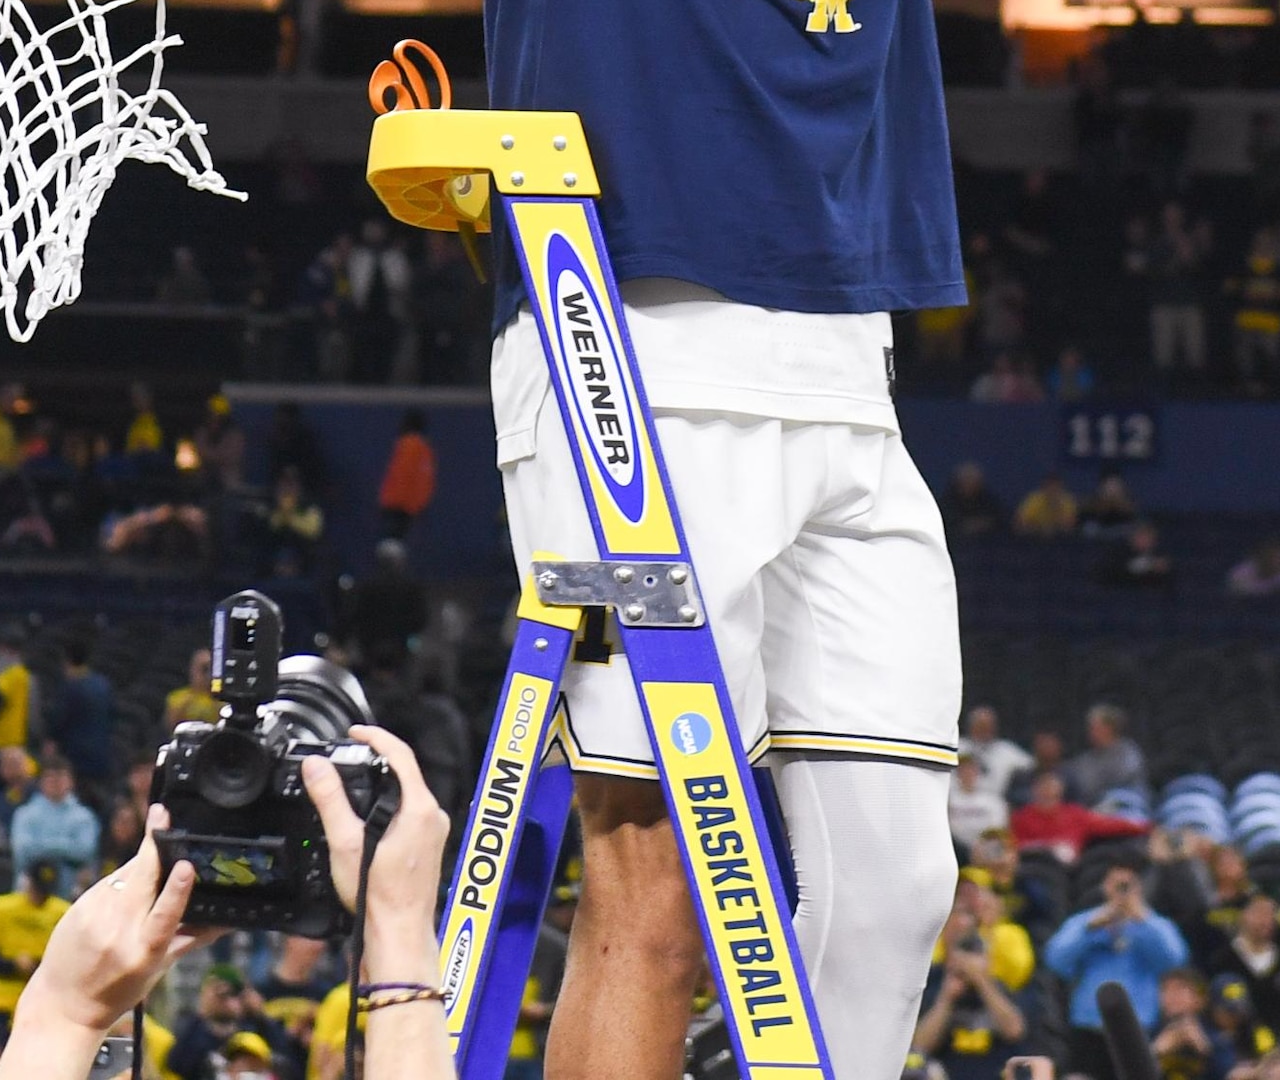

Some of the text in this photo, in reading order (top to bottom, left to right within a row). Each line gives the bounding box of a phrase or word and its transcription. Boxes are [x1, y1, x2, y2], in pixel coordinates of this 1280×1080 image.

[562, 291, 629, 465] WERNER
[1070, 414, 1154, 458] 112
[460, 687, 536, 911] PODIUM PODIO
[444, 936, 469, 1001] WERNER
[683, 775, 794, 1038] BASKETBALL
